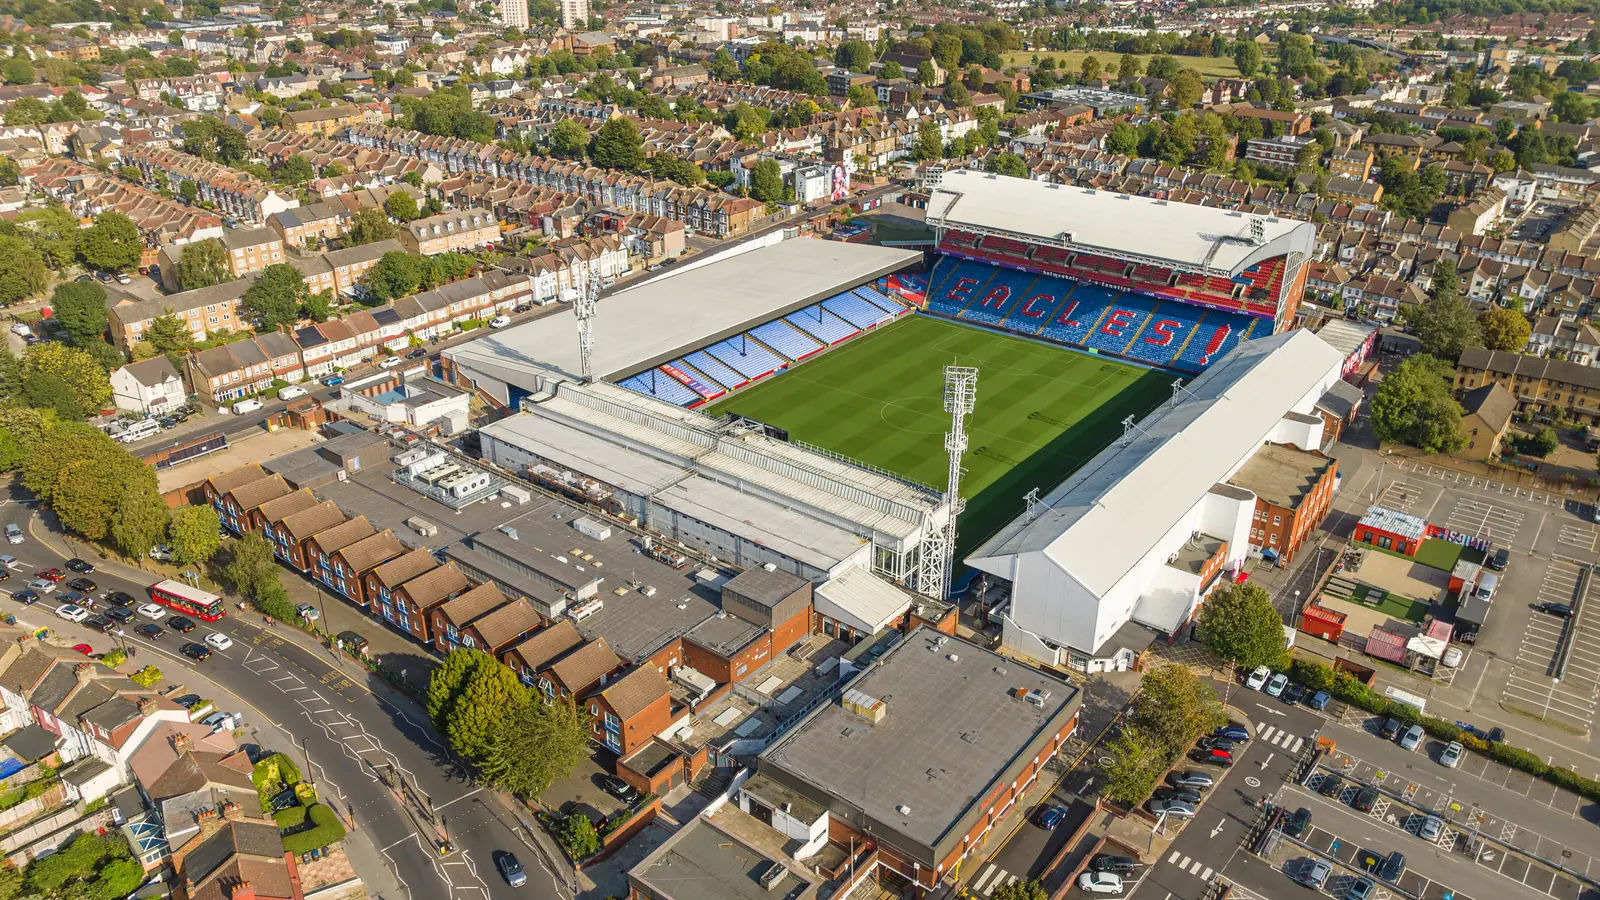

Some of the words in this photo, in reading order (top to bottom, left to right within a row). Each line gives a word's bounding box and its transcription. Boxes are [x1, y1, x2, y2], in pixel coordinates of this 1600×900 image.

[947, 277, 1231, 365] EAGLES!
[319, 670, 342, 685] STOP
[333, 679, 353, 691] BUS
